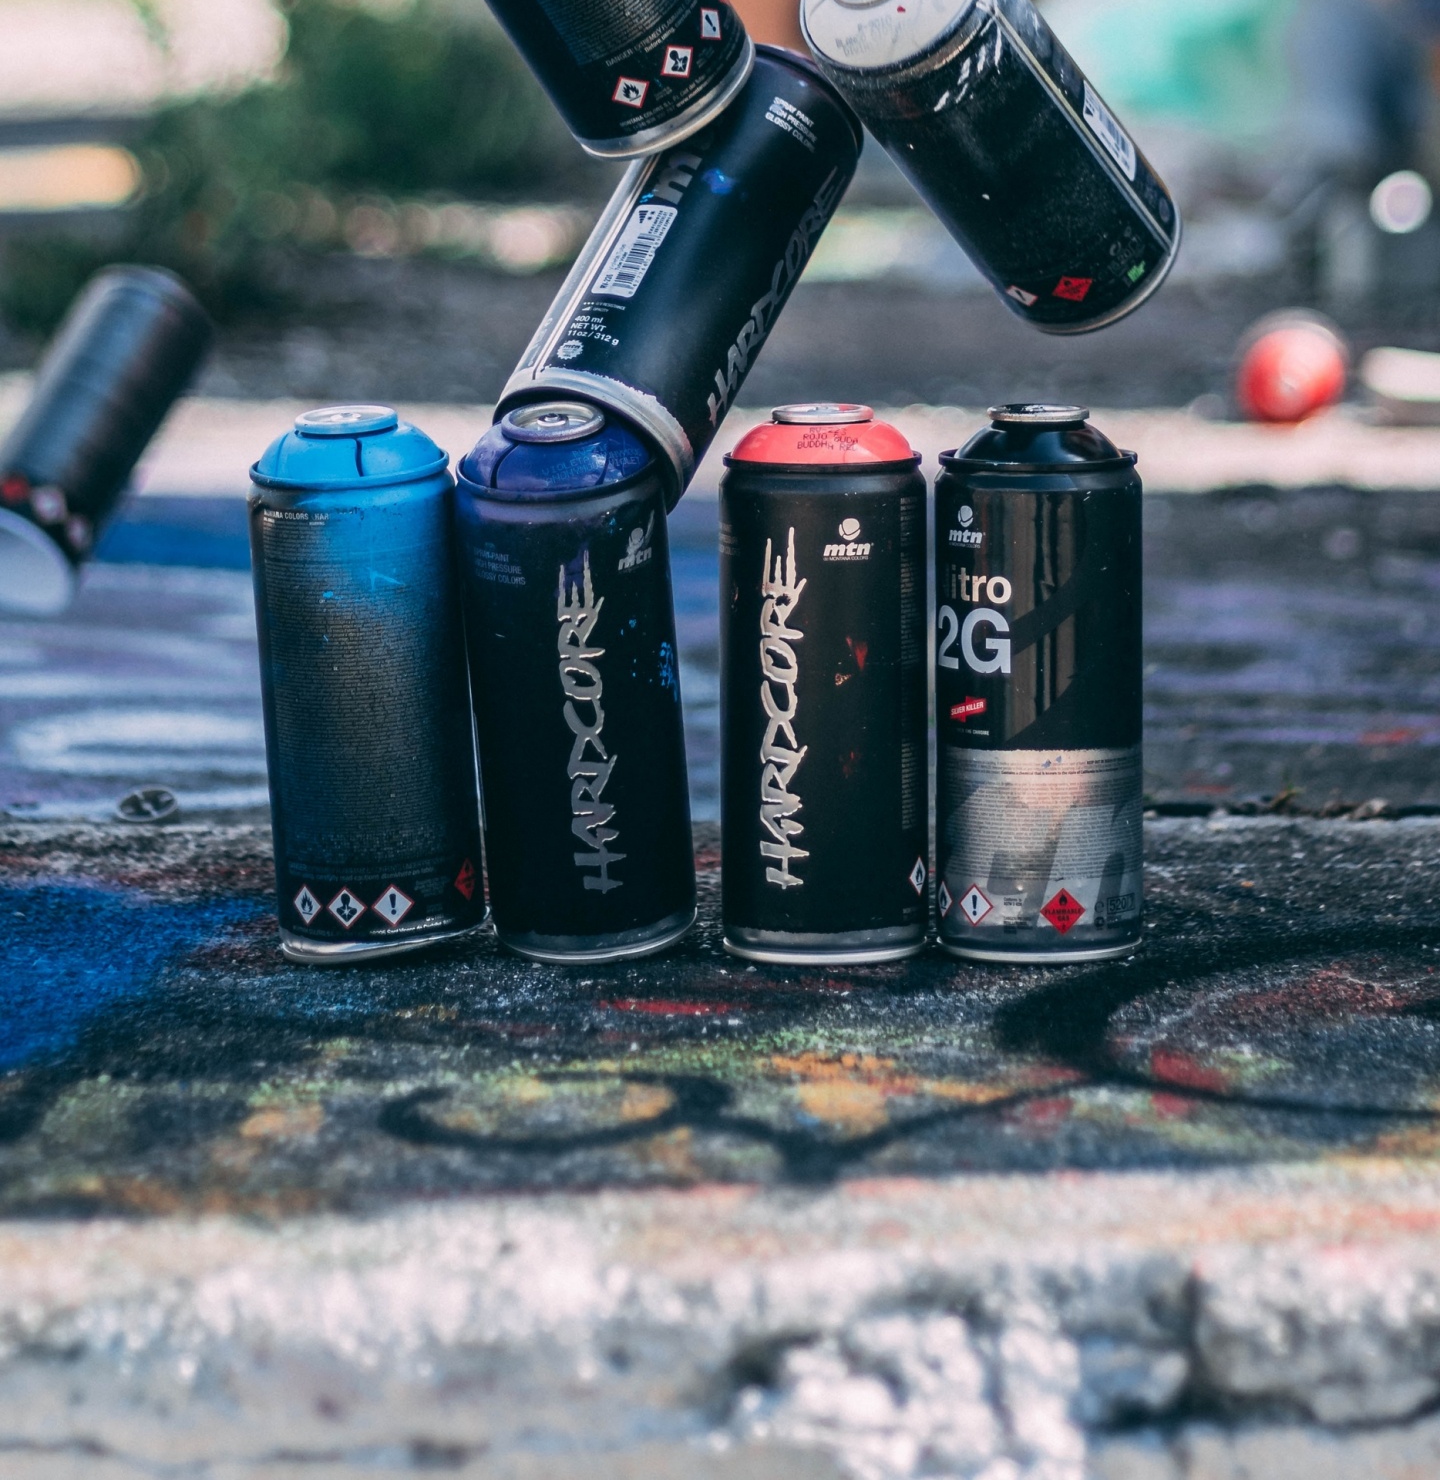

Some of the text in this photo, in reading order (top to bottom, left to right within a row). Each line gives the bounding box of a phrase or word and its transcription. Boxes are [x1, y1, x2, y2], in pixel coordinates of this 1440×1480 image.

[773, 96, 815, 127] SPRAY PAINT
[765, 112, 793, 132] GLOSSY
[590, 323, 607, 332] WT
[594, 333, 612, 342] 312
[802, 432, 828, 440] ROJO
[284, 511, 309, 520] COLORS
[948, 529, 983, 544] mtn
[823, 541, 871, 557] mtn
[618, 546, 653, 571] mtn
[487, 561, 523, 575] PRESSURE
[497, 574, 526, 586] COLORS
[945, 563, 1012, 604] itro
[938, 604, 1012, 674] 2G
[760, 526, 810, 890] HARDCORE
[965, 701, 984, 712] KILLER
[556, 550, 627, 894] HARDCORE
